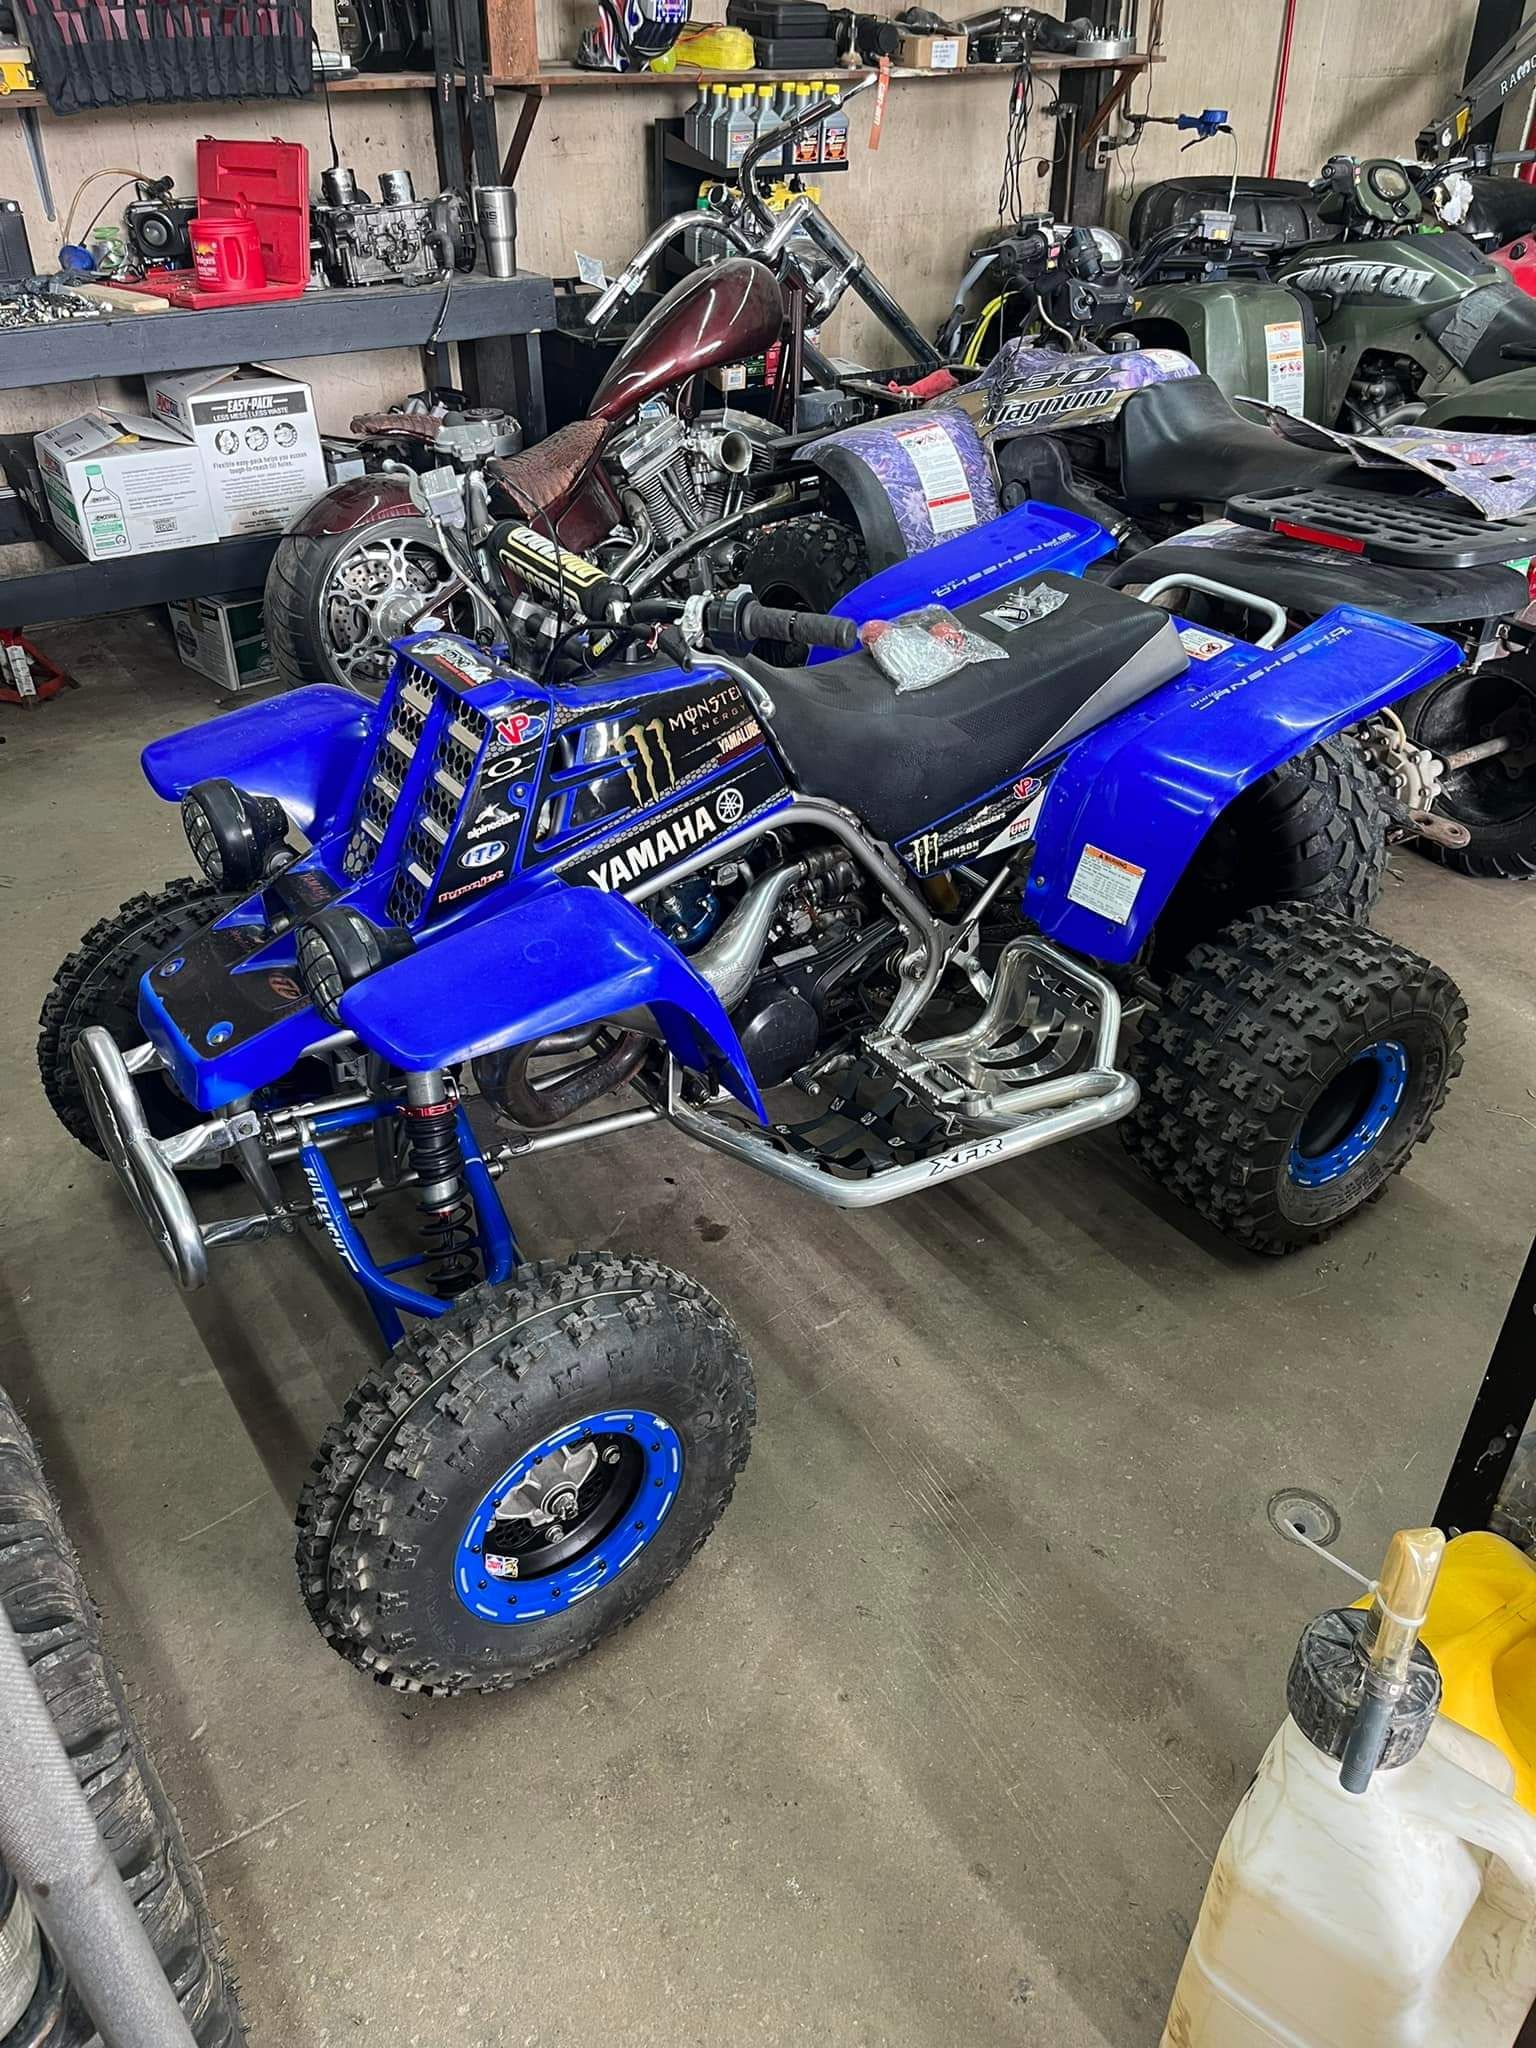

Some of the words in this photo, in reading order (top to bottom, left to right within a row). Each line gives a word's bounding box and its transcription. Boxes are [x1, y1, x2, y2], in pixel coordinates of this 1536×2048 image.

[1296, 263, 1386, 294] ARCTIC
[1379, 266, 1436, 298] CAT
[213, 413, 230, 422] LESS
[251, 409, 268, 418] LESS
[268, 407, 289, 416] WASTE
[227, 396, 274, 413] EASY-PACK
[668, 685, 742, 732] MONSTE
[691, 703, 746, 736] ENERGY
[495, 712, 530, 746] VP
[1013, 777, 1034, 798] VP
[467, 811, 521, 840] alpinestars
[1009, 818, 1031, 837] UNI
[464, 842, 502, 865] ITP
[587, 806, 717, 893] YAMAHA
[929, 1138, 1003, 1176] XFR
